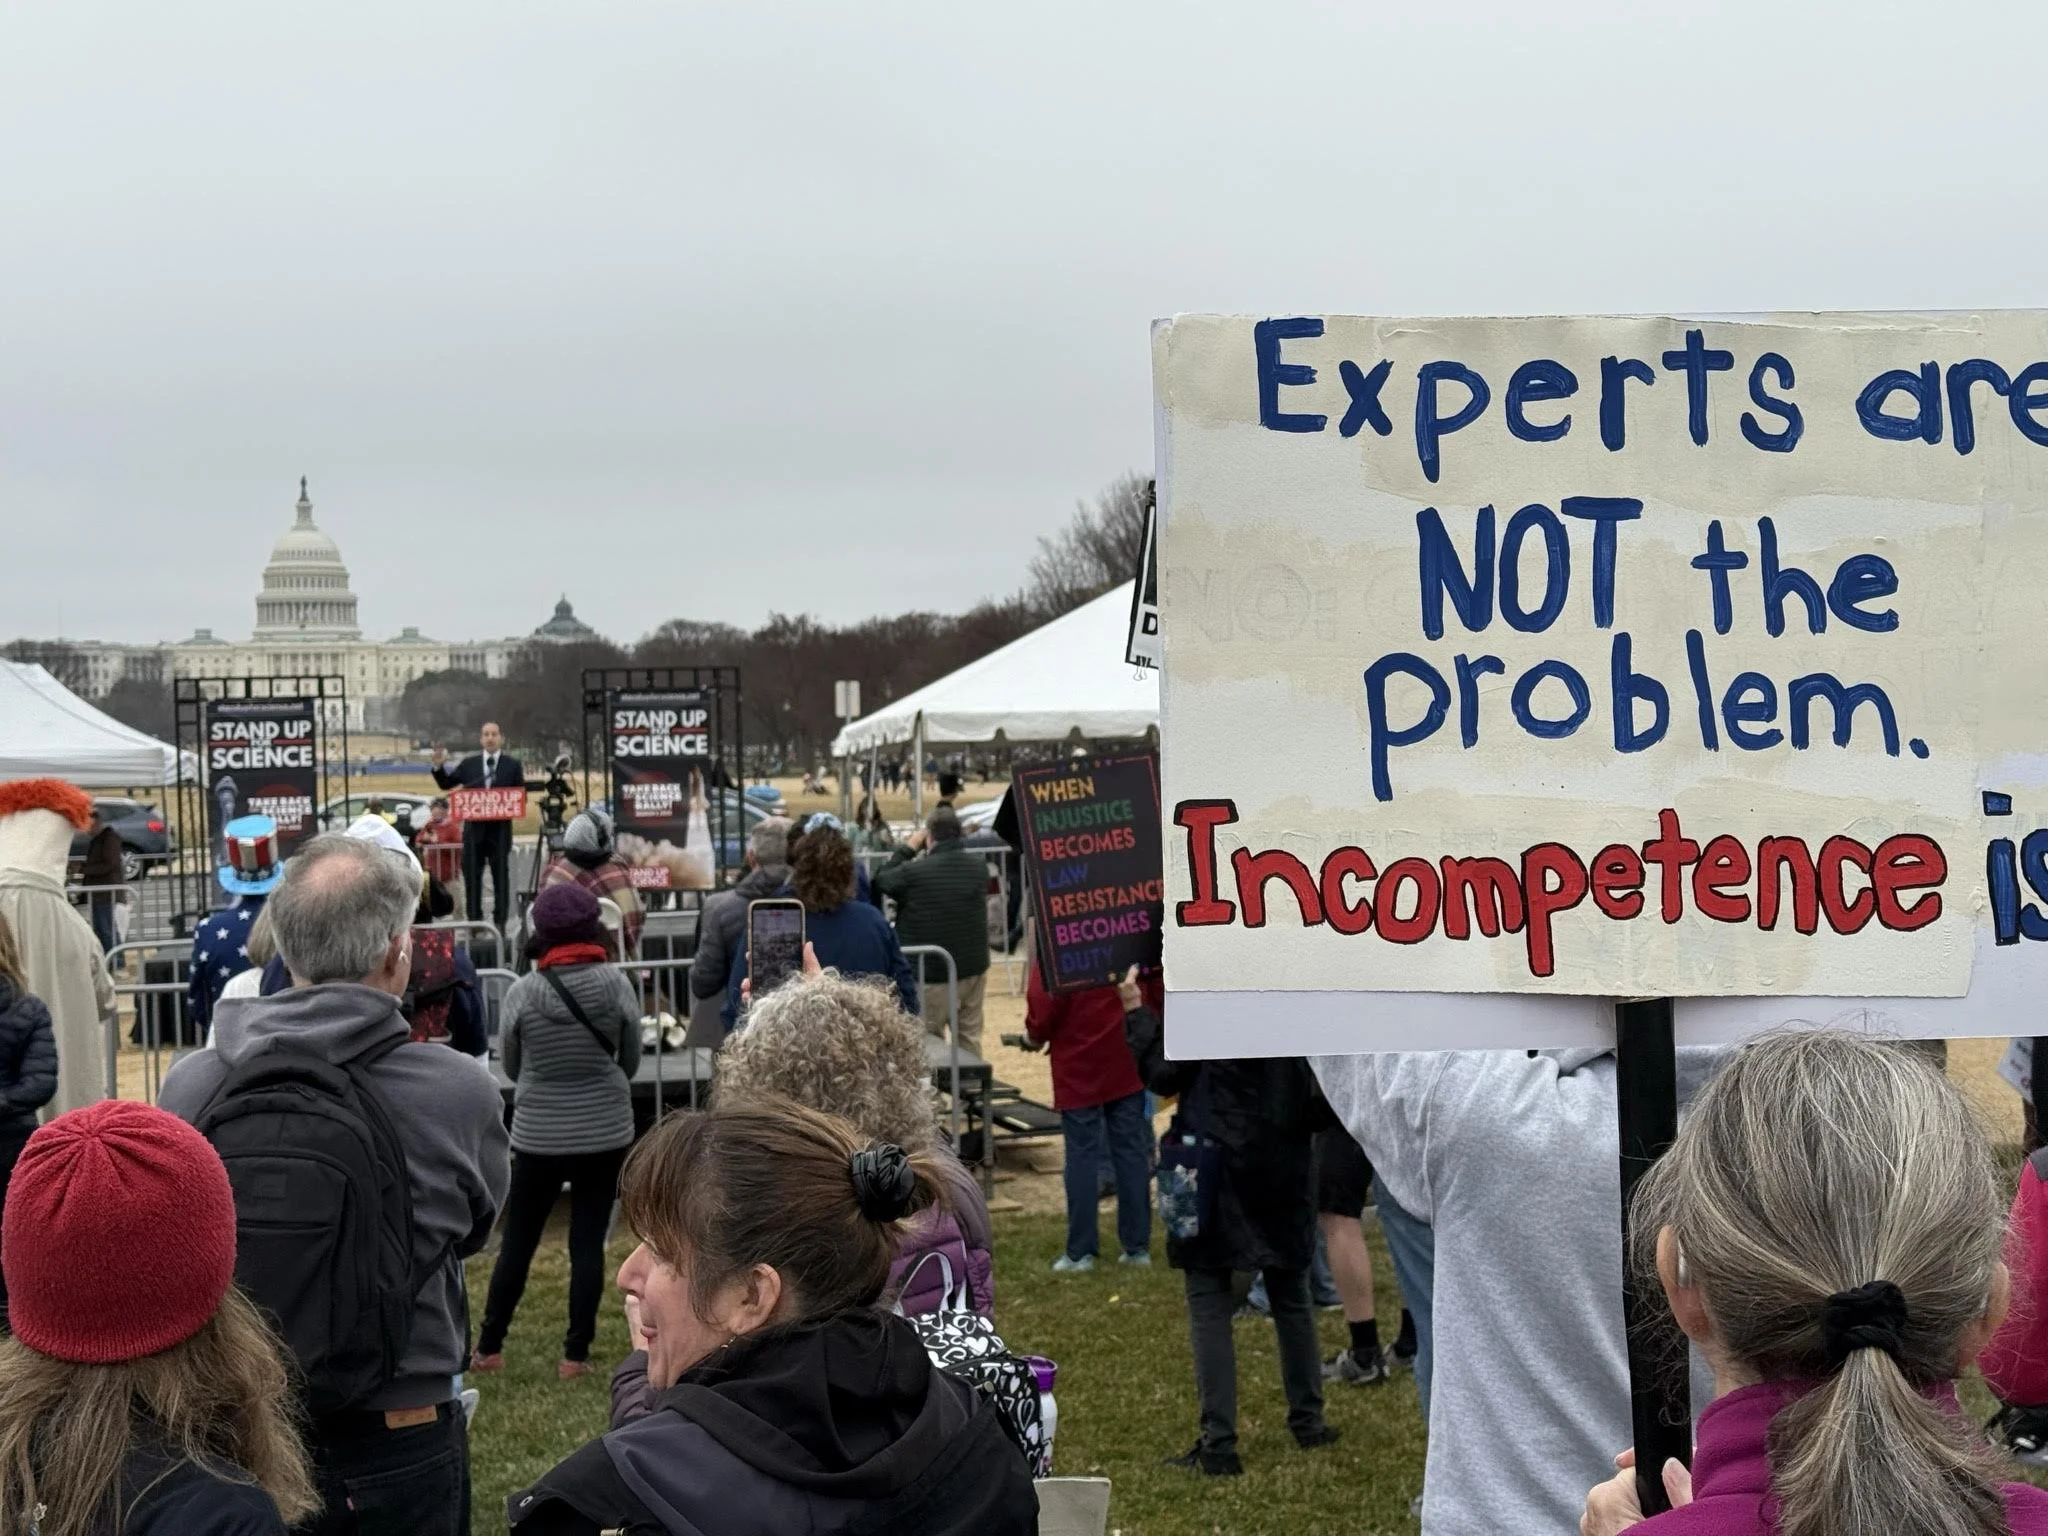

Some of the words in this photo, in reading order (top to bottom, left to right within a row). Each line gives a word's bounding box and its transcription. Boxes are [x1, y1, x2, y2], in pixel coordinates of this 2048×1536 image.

[1255, 318, 1803, 481] Experts
[1856, 359, 2048, 454] are
[1417, 497, 1642, 640] NOT
[1692, 516, 1898, 633] the
[615, 709, 678, 729] STAND
[681, 709, 708, 728] UP
[1364, 630, 1929, 801] problem.
[211, 721, 280, 741] STAND
[283, 720, 312, 740] UP
[211, 745, 313, 770] SCIENCE
[614, 733, 708, 757] SCIENCE
[454, 790, 501, 807] STAND
[503, 790, 523, 804] UP
[1030, 776, 1096, 804] WHEN
[462, 803, 521, 818] SCIENCE
[1033, 799, 1135, 834] INJUSTICE
[1040, 827, 1136, 861] BECOMES
[1046, 862, 1088, 889] LAW
[1173, 798, 1948, 977] Incompetence
[1055, 910, 1150, 946] BECOMES
[1061, 945, 1113, 974] DUTY
